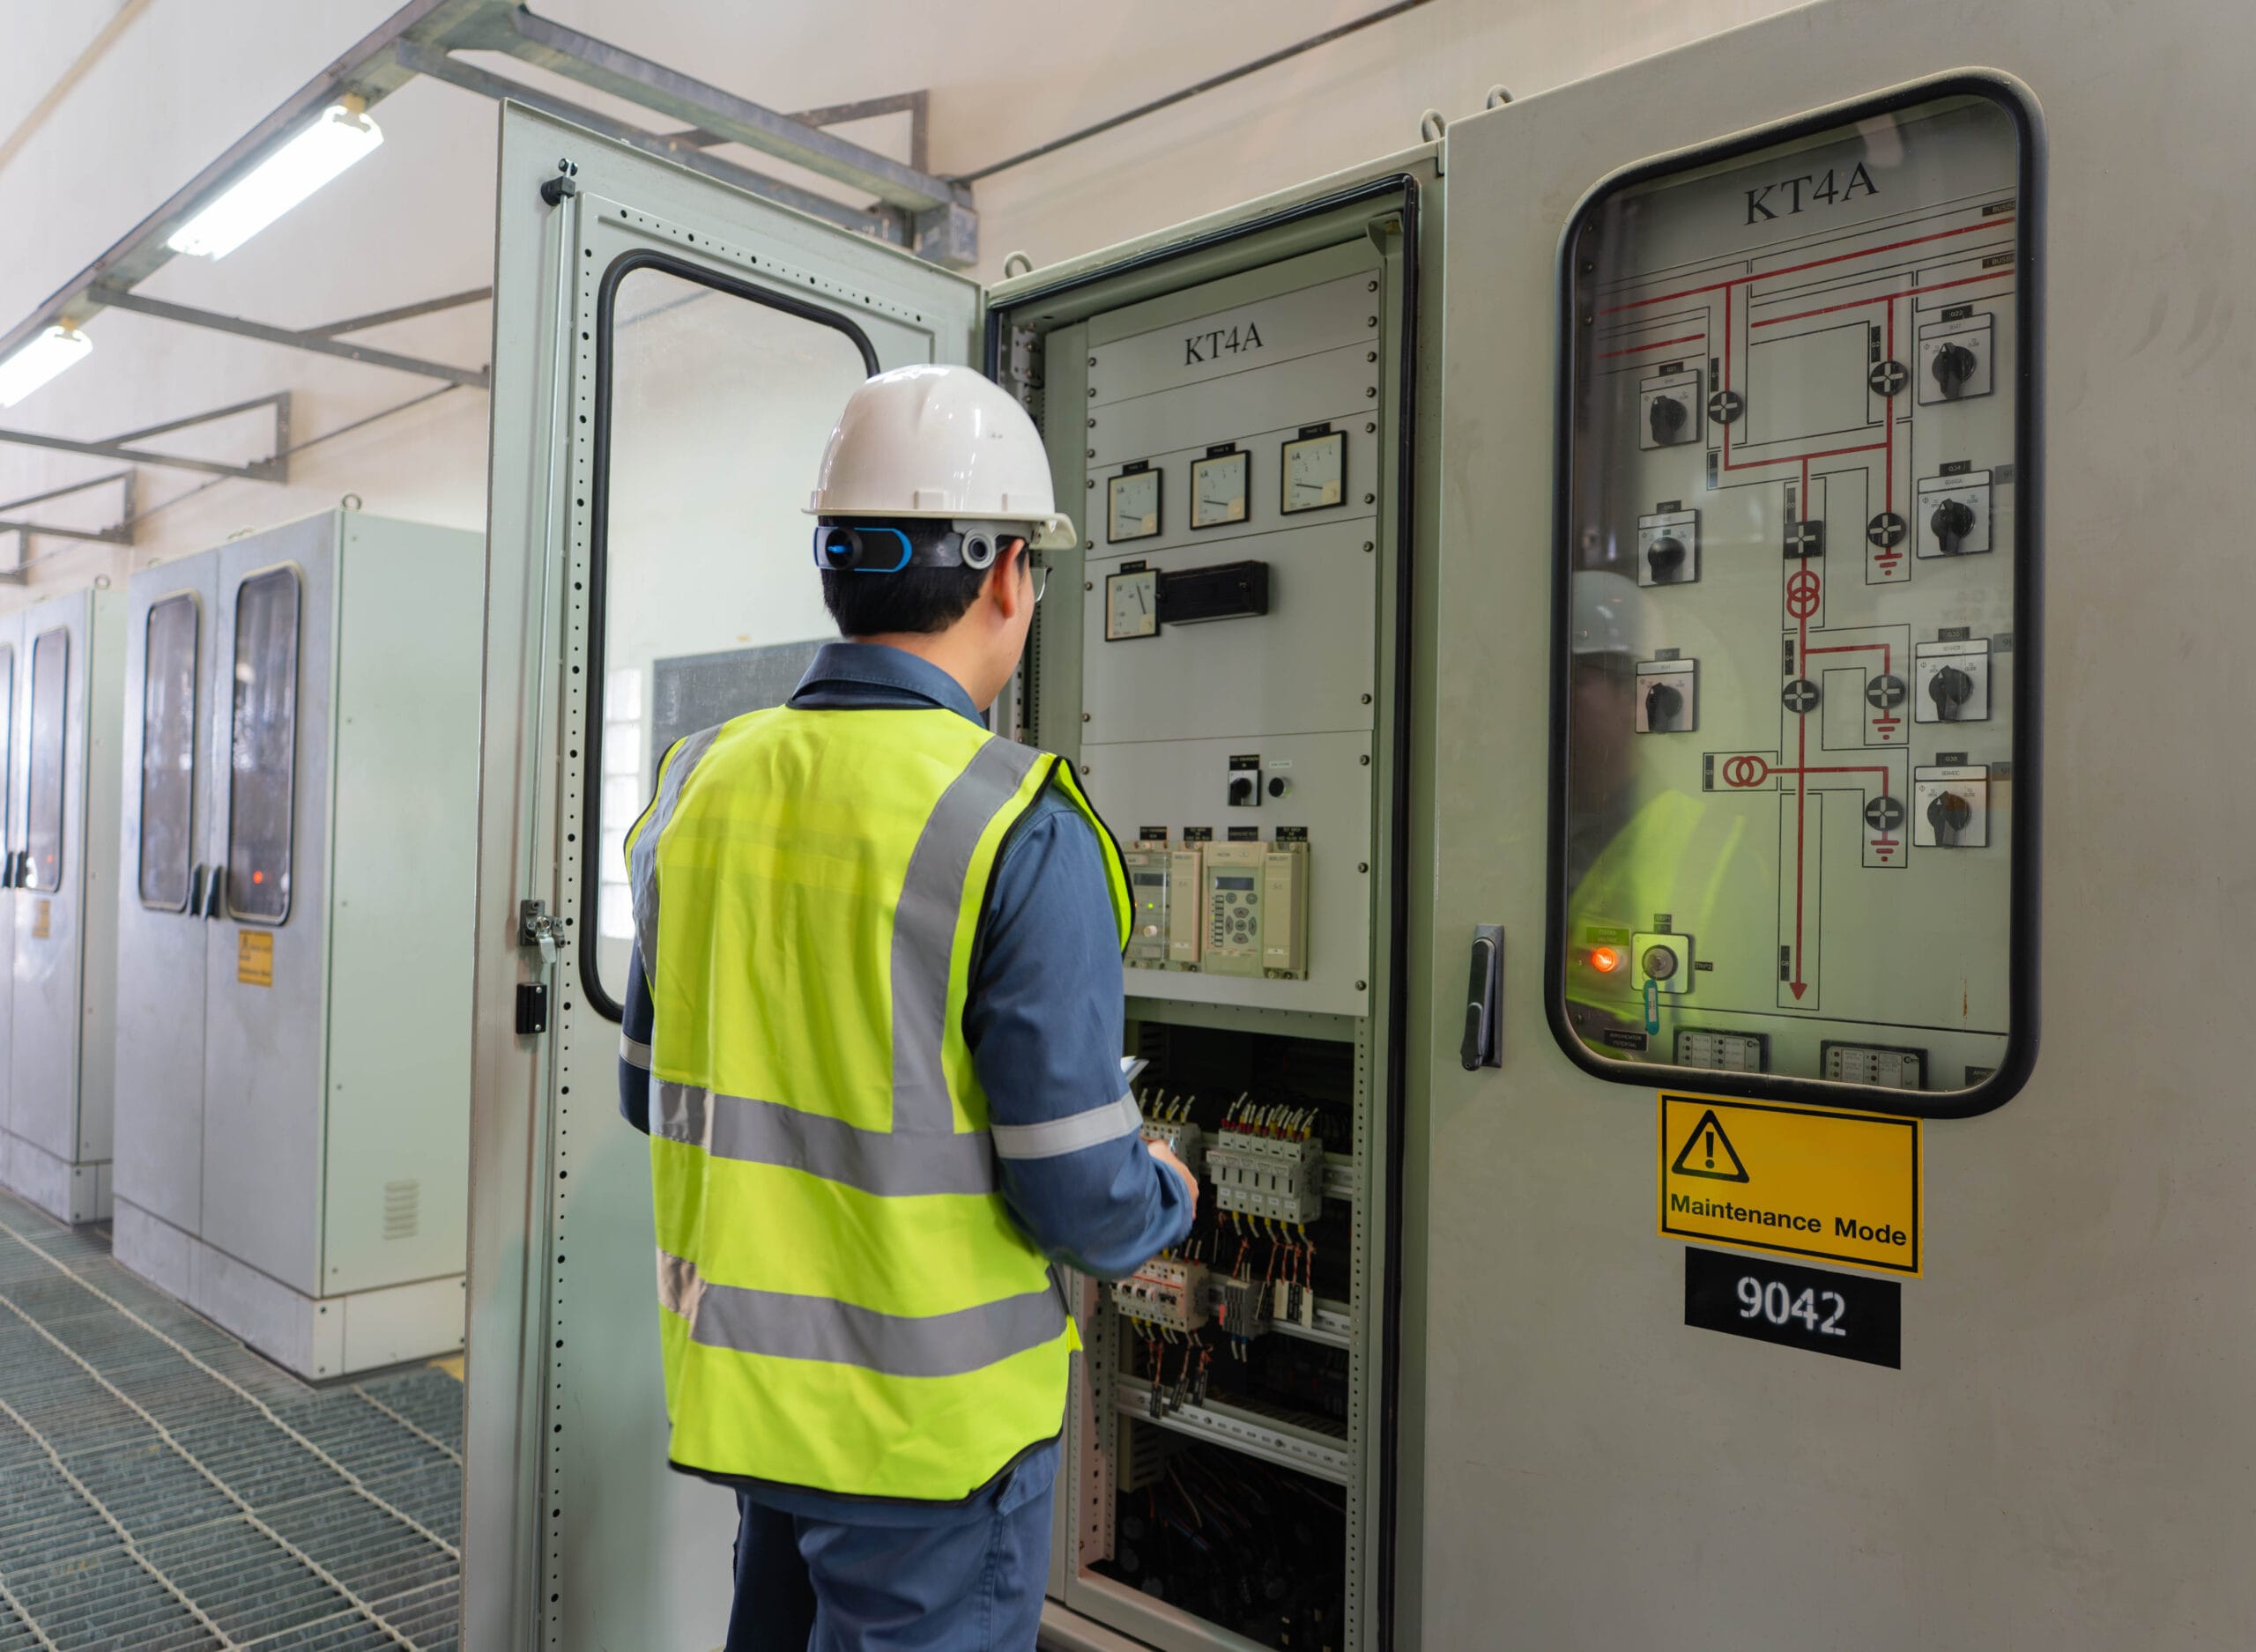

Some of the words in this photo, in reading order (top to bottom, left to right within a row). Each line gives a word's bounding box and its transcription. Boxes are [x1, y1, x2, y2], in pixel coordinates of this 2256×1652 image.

[1744, 162, 1880, 226] KT4A
[1184, 322, 1265, 366] KT4A
[1671, 1193, 1822, 1234] Maintenance
[1835, 1218, 1907, 1247] Mode
[1737, 1277, 1846, 1337] 9042
